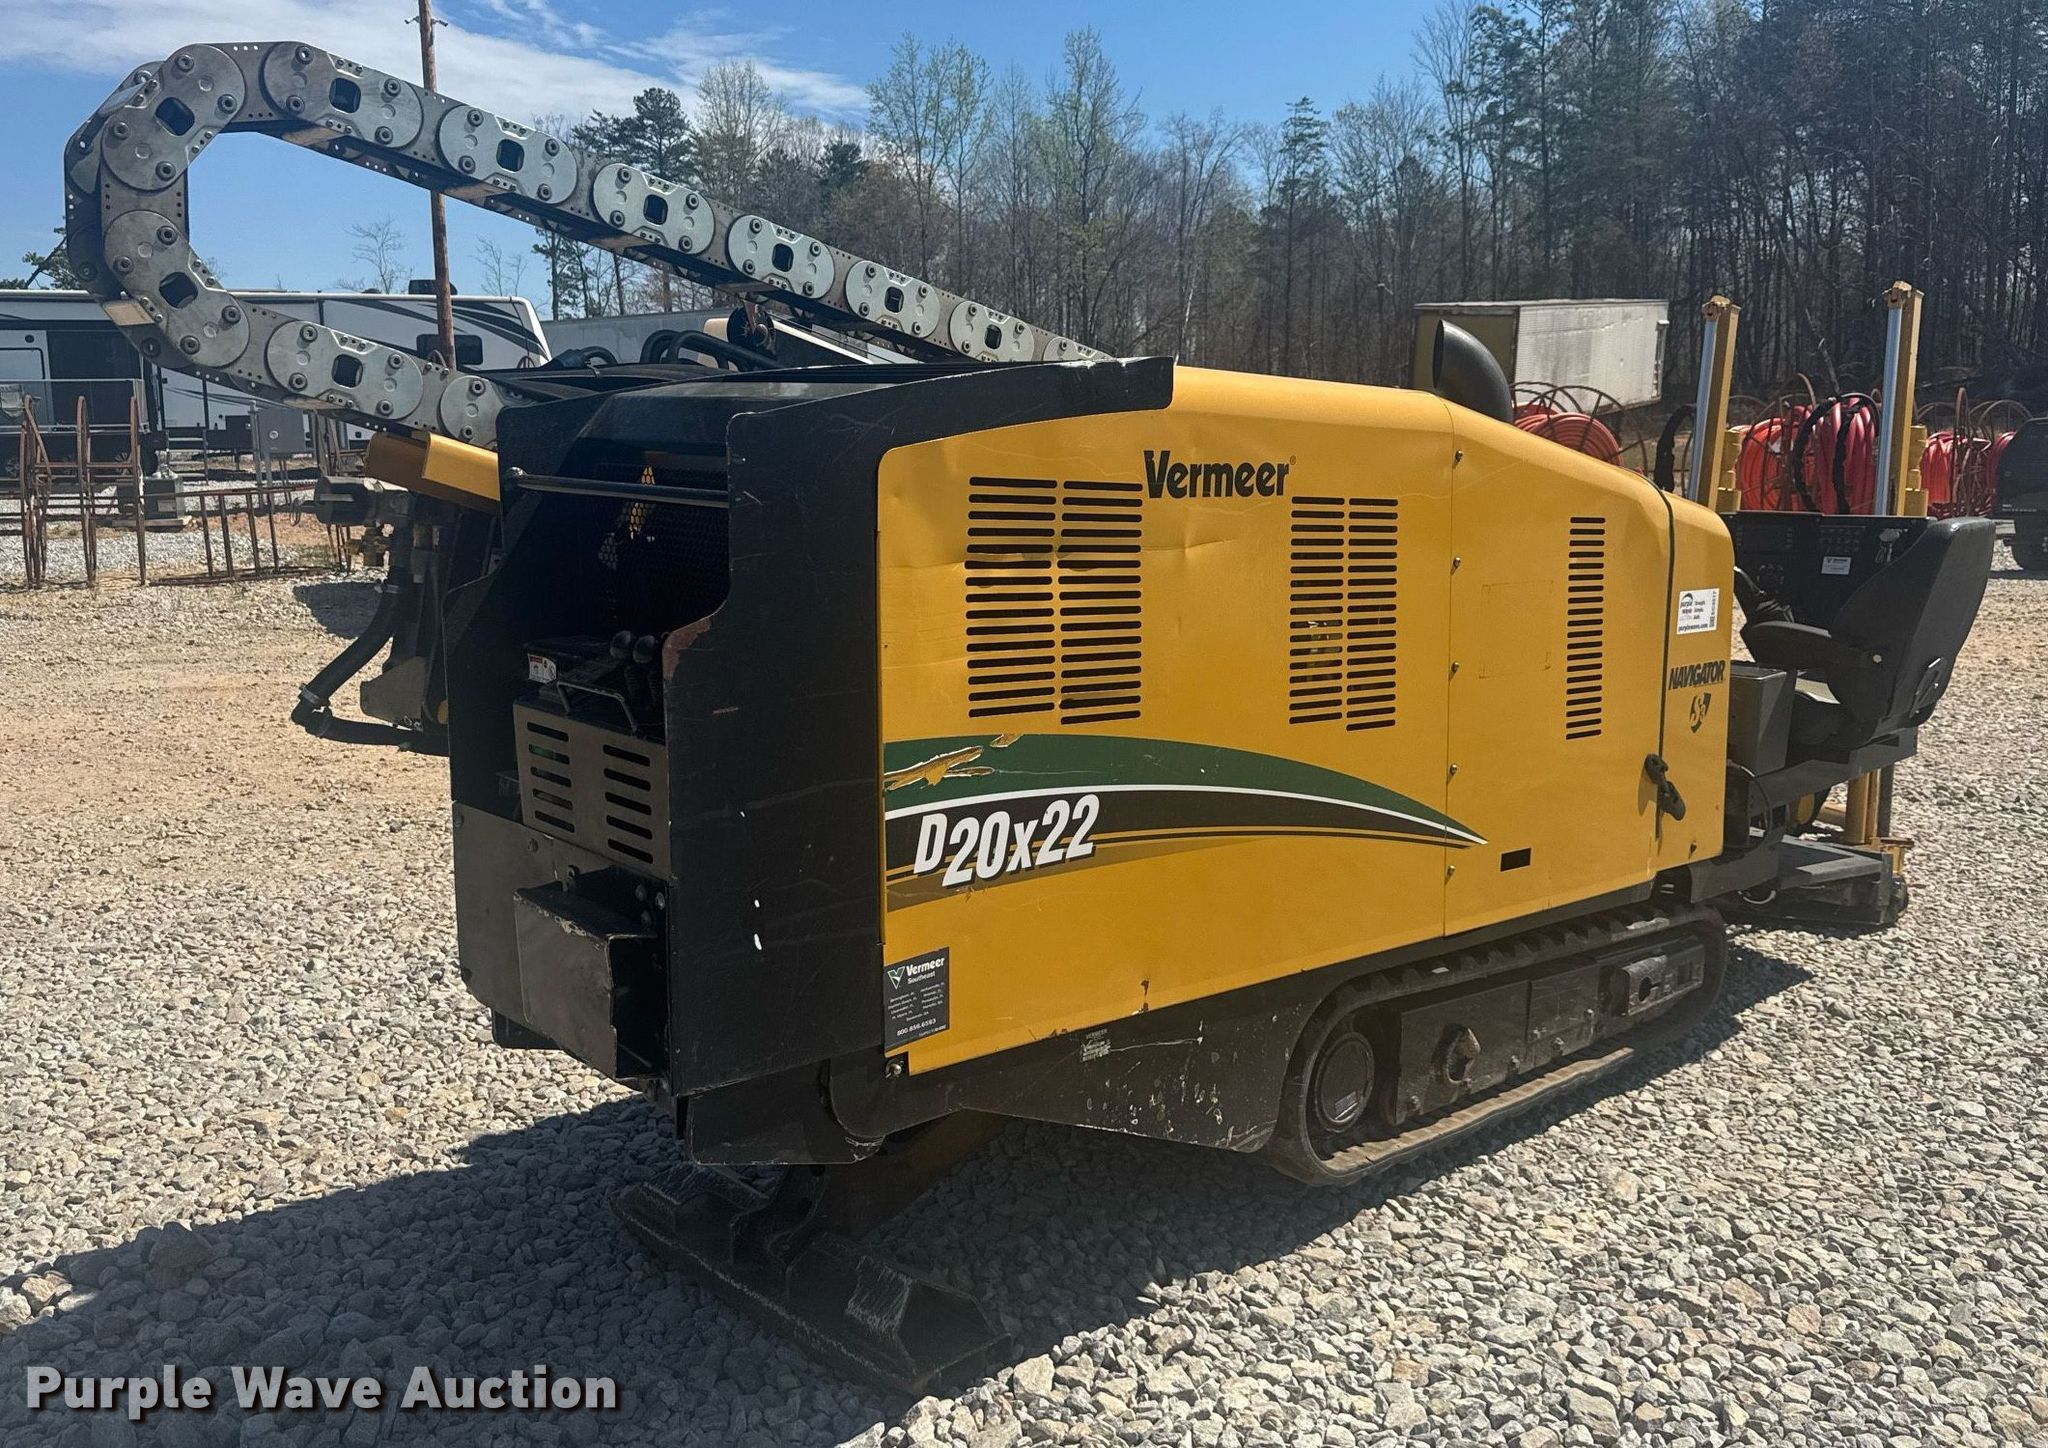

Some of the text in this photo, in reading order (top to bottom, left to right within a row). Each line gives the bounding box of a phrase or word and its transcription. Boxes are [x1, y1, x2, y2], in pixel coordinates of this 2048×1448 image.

[1144, 450, 1290, 498] Vermeer
[1668, 660, 1725, 690] NAVIGATOR
[914, 794, 1099, 887] D20x22
[906, 958, 945, 976] Vermeer
[907, 971, 936, 984] Southeast
